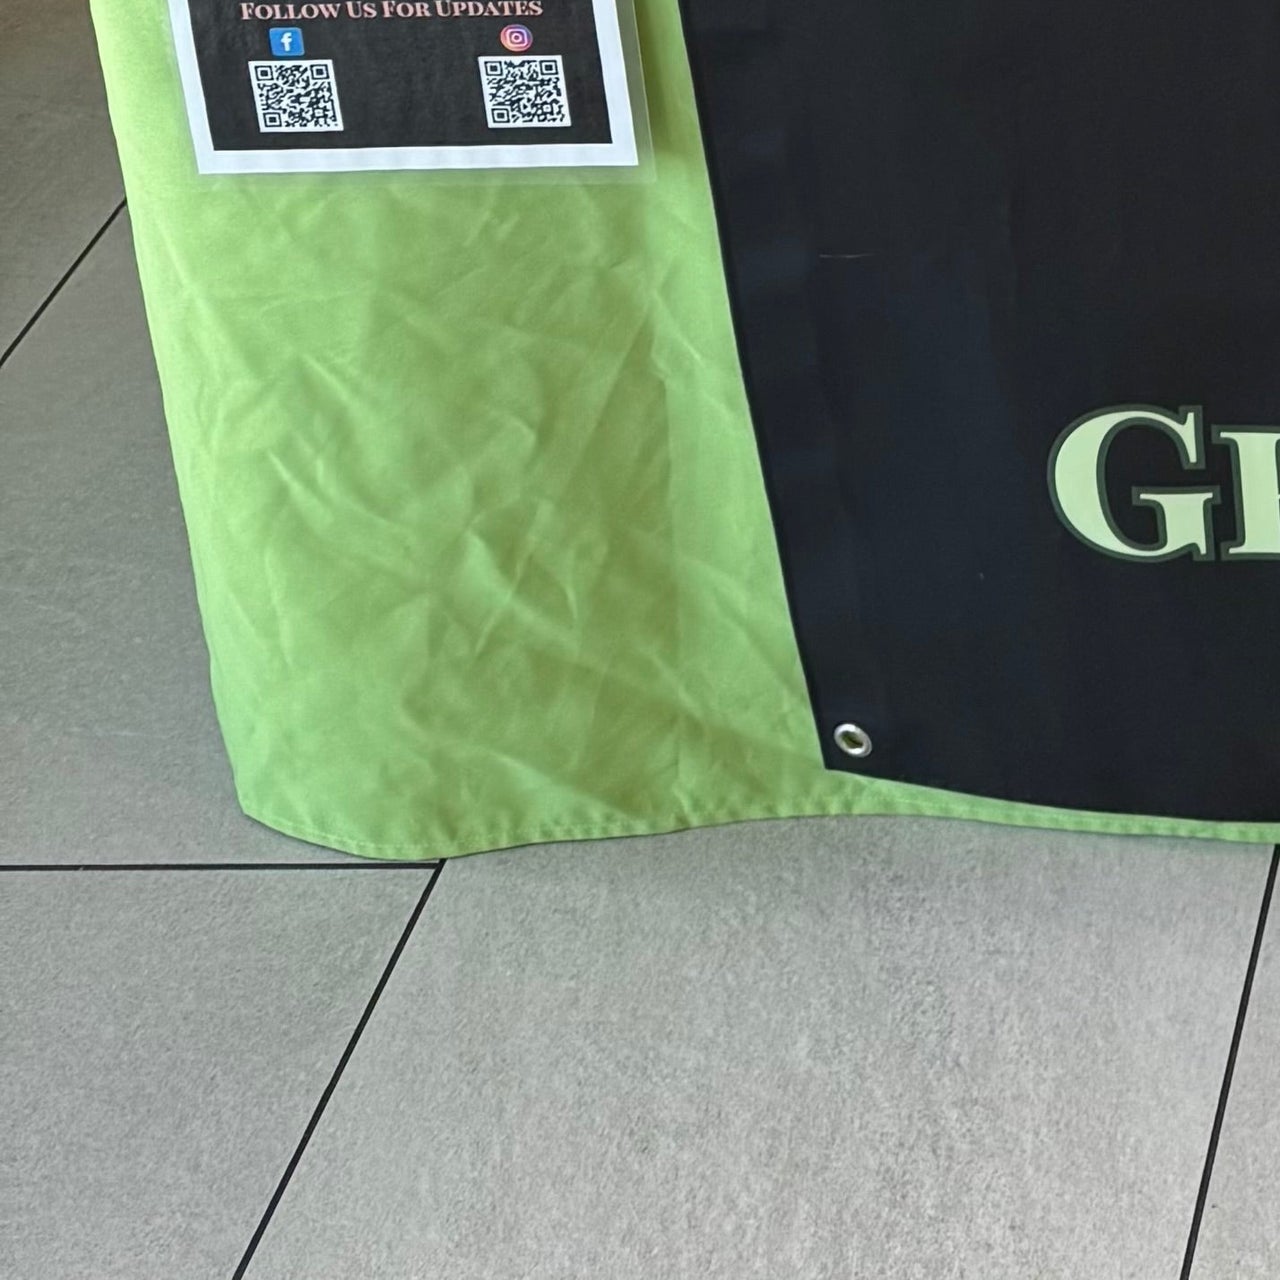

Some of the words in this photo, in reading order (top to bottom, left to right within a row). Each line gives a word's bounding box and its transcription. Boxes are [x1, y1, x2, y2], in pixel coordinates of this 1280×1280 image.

[240, 2, 342, 21] FOLLOW
[346, 1, 377, 18] US
[382, 1, 431, 18] FOR
[435, 0, 543, 17] UPDATES
